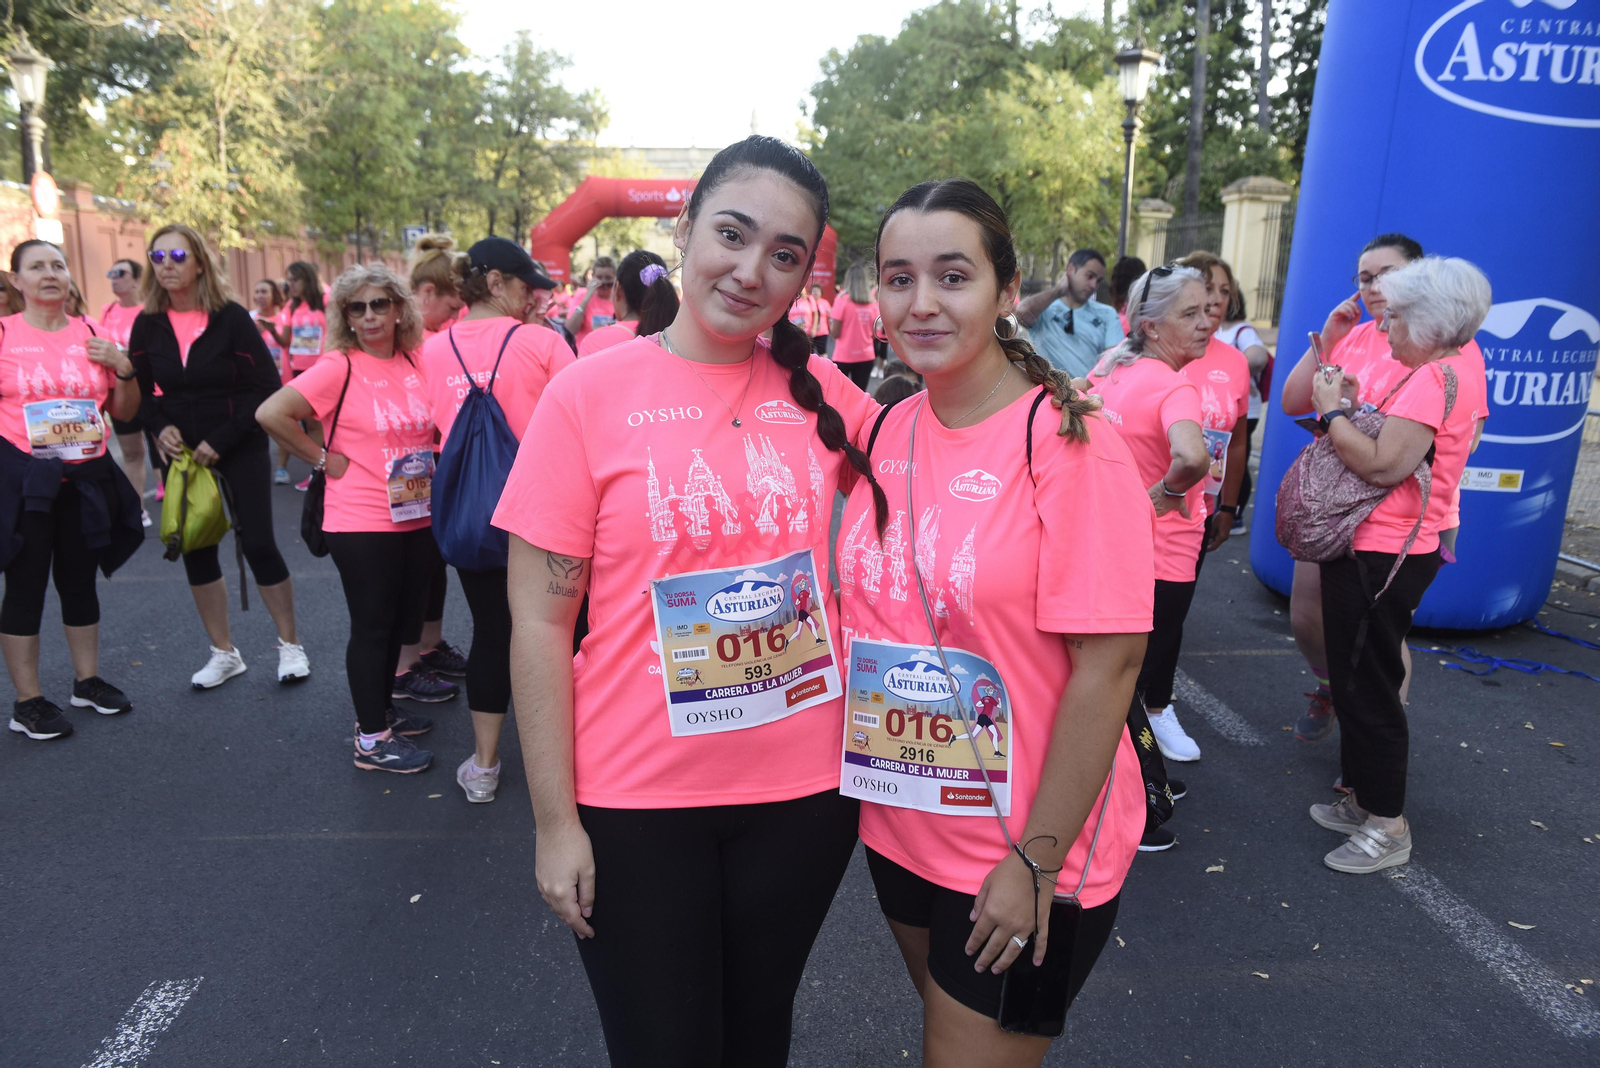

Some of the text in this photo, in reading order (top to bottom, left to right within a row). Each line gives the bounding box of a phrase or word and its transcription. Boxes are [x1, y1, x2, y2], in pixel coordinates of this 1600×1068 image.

[1501, 18, 1600, 37] CENTRA
[628, 187, 665, 203] Sports
[627, 406, 703, 427] OYSHO
[52, 422, 82, 436] 016
[952, 480, 996, 495] ASTURIANA
[547, 581, 579, 598] Abuelo
[754, 588, 780, 598] LECHERA
[667, 597, 697, 608] SUMA
[713, 593, 782, 615] ASTURIANA
[716, 624, 786, 662] 016
[857, 663, 877, 674] SUMA
[863, 658, 878, 666] DORSAL
[744, 663, 772, 680] 593
[705, 667, 803, 699] CARRERA DE LA MUJER
[795, 682, 820, 698] Santander
[887, 673, 953, 694] ASTURIANA
[686, 707, 743, 725] OYSHO
[886, 709, 953, 743] 016
[900, 746, 935, 763] 2916
[870, 757, 969, 780] CARRERA DE LA MUJER
[853, 775, 898, 795] OYSHO
[955, 793, 986, 801] Santander
